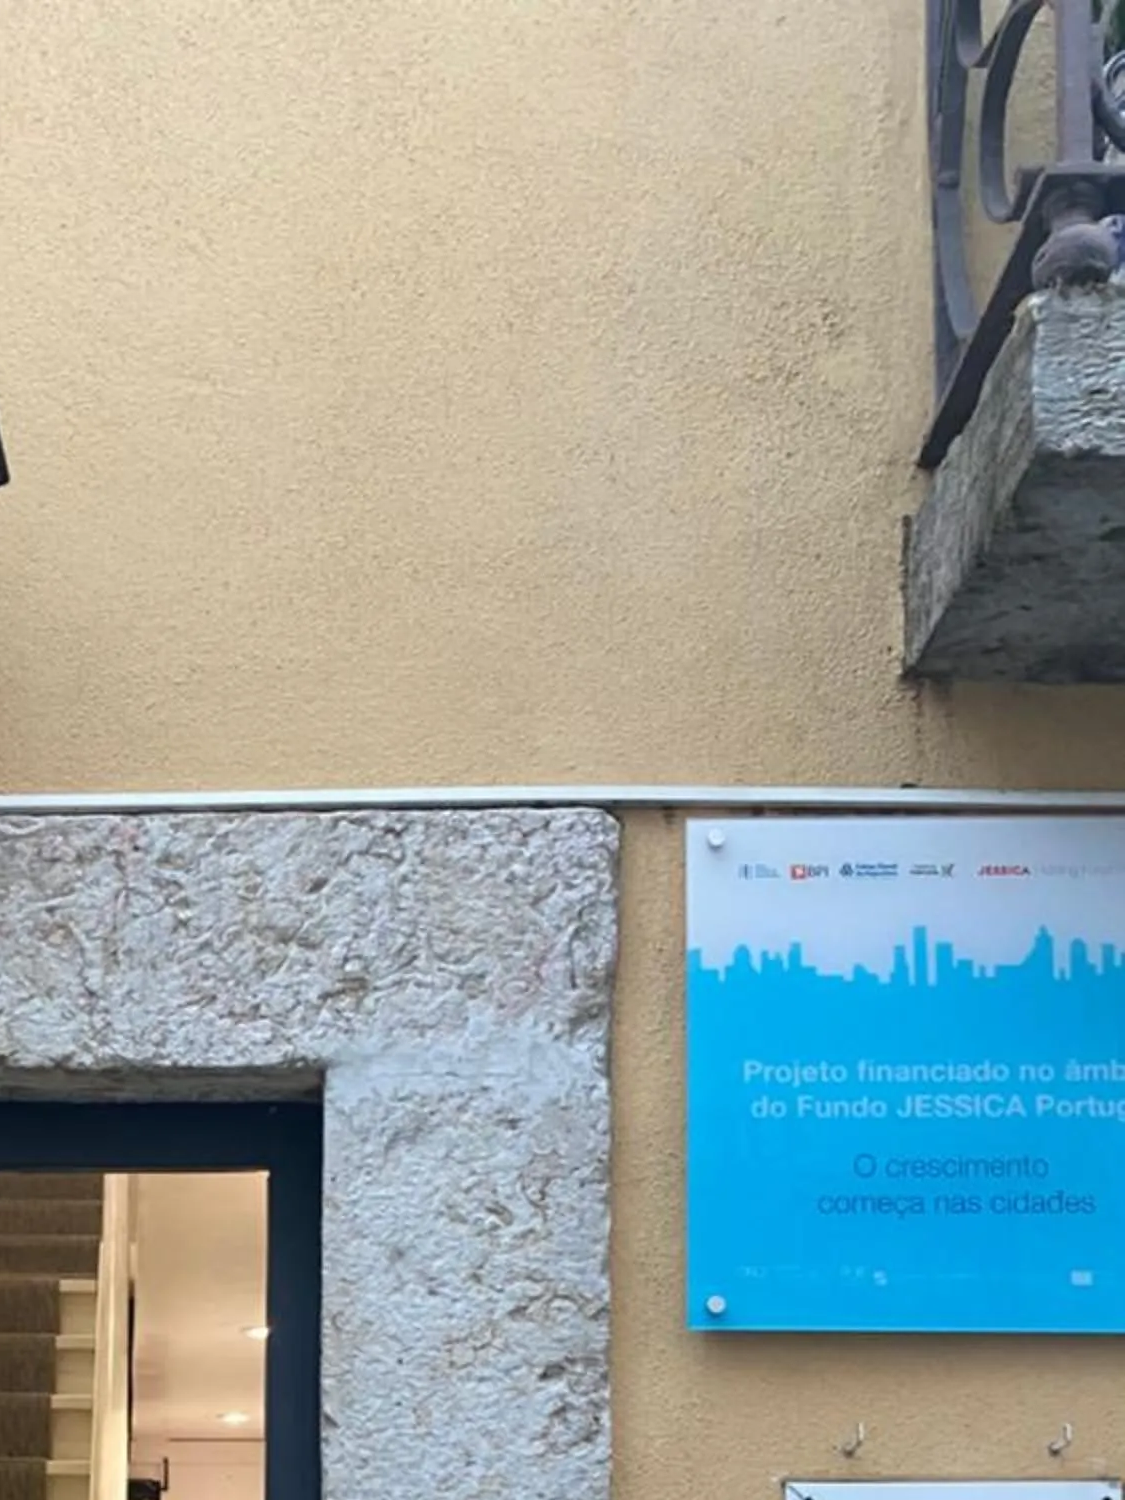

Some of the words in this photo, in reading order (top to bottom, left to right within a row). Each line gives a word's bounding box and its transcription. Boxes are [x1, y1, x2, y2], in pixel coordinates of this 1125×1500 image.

[976, 864, 1030, 877] JESSICA
[743, 1059, 847, 1087] Projeto
[858, 1059, 1009, 1083] financiado
[1019, 1063, 1055, 1082] no
[751, 1096, 787, 1119] do
[797, 1095, 887, 1119] Fundo
[896, 1094, 1027, 1119] JESSICA
[853, 1154, 877, 1179] O
[885, 1155, 1049, 1179] crescimento
[818, 1193, 924, 1219] começa
[934, 1194, 982, 1215] nas
[989, 1190, 1096, 1215] cidades
